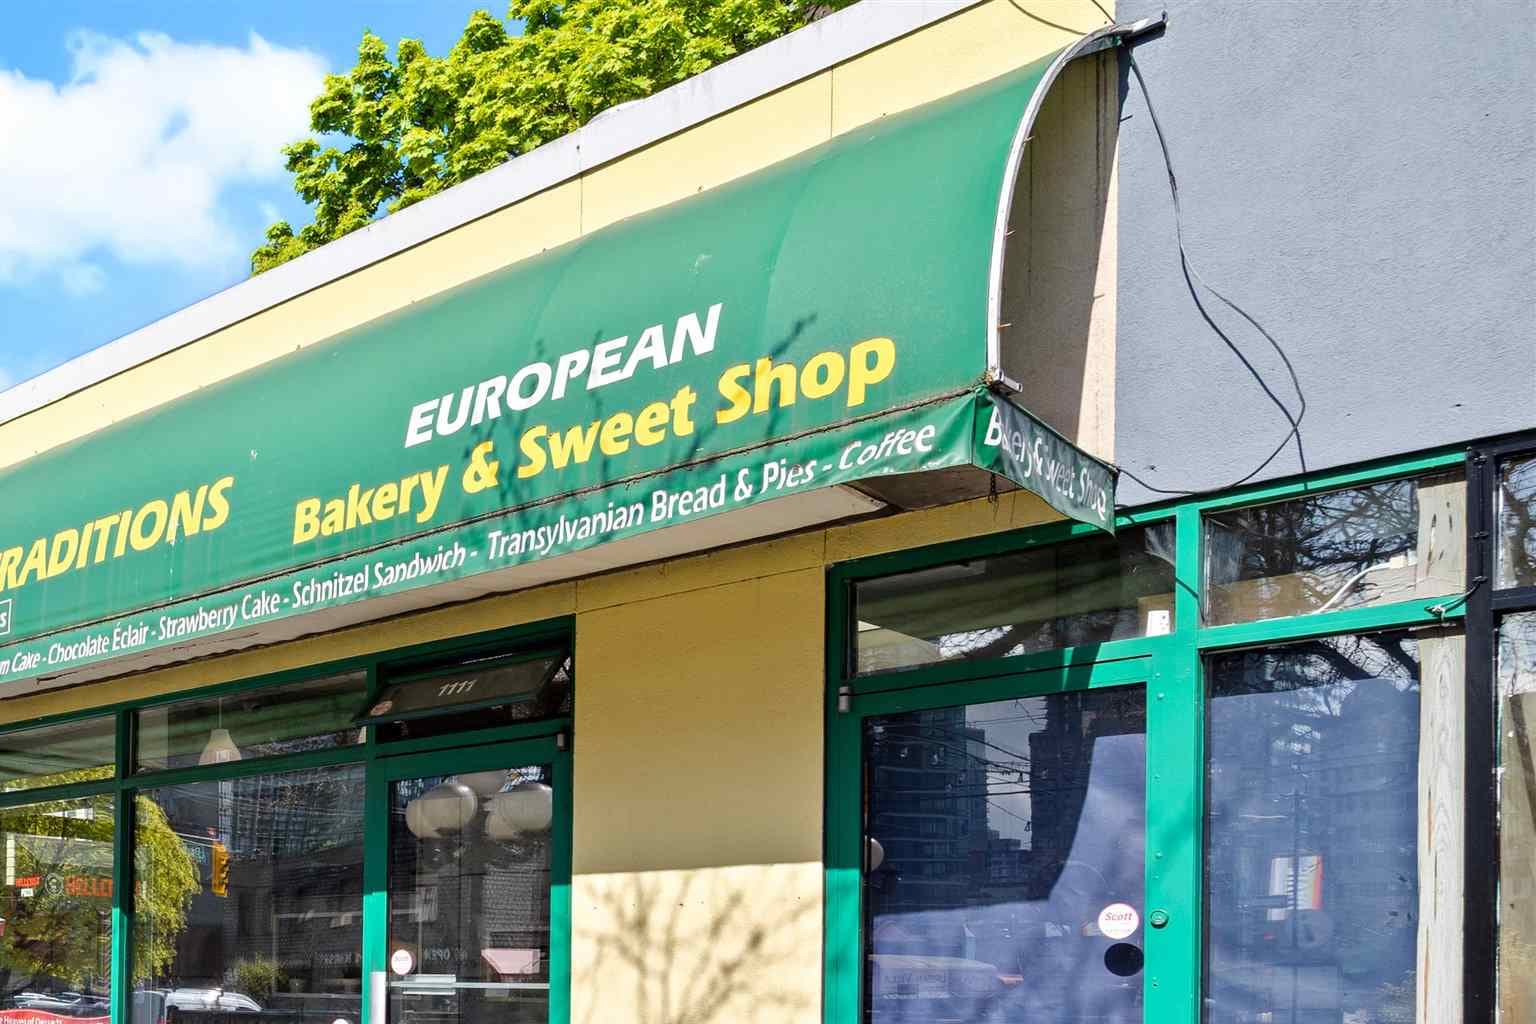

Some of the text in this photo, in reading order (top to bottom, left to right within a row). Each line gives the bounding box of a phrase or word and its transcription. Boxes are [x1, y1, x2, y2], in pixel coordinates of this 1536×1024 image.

[292, 336, 897, 546] Bakery & Sweet Shop
[404, 302, 723, 448] EUROPEAN
[11, 651, 41, 672] Cake
[48, 635, 110, 664] Chocolate
[112, 621, 149, 650] Éclair
[158, 604, 238, 641] Strawberry
[241, 590, 280, 620] Cake
[292, 564, 370, 609] Schnitzel
[373, 542, 466, 589] Sandwich
[487, 502, 644, 561] Transylvanian
[650, 474, 727, 523] Bread
[734, 468, 753, 501] &
[760, 458, 817, 495] Pies
[838, 424, 937, 471] Coffee
[1104, 911, 1134, 921] Scott
